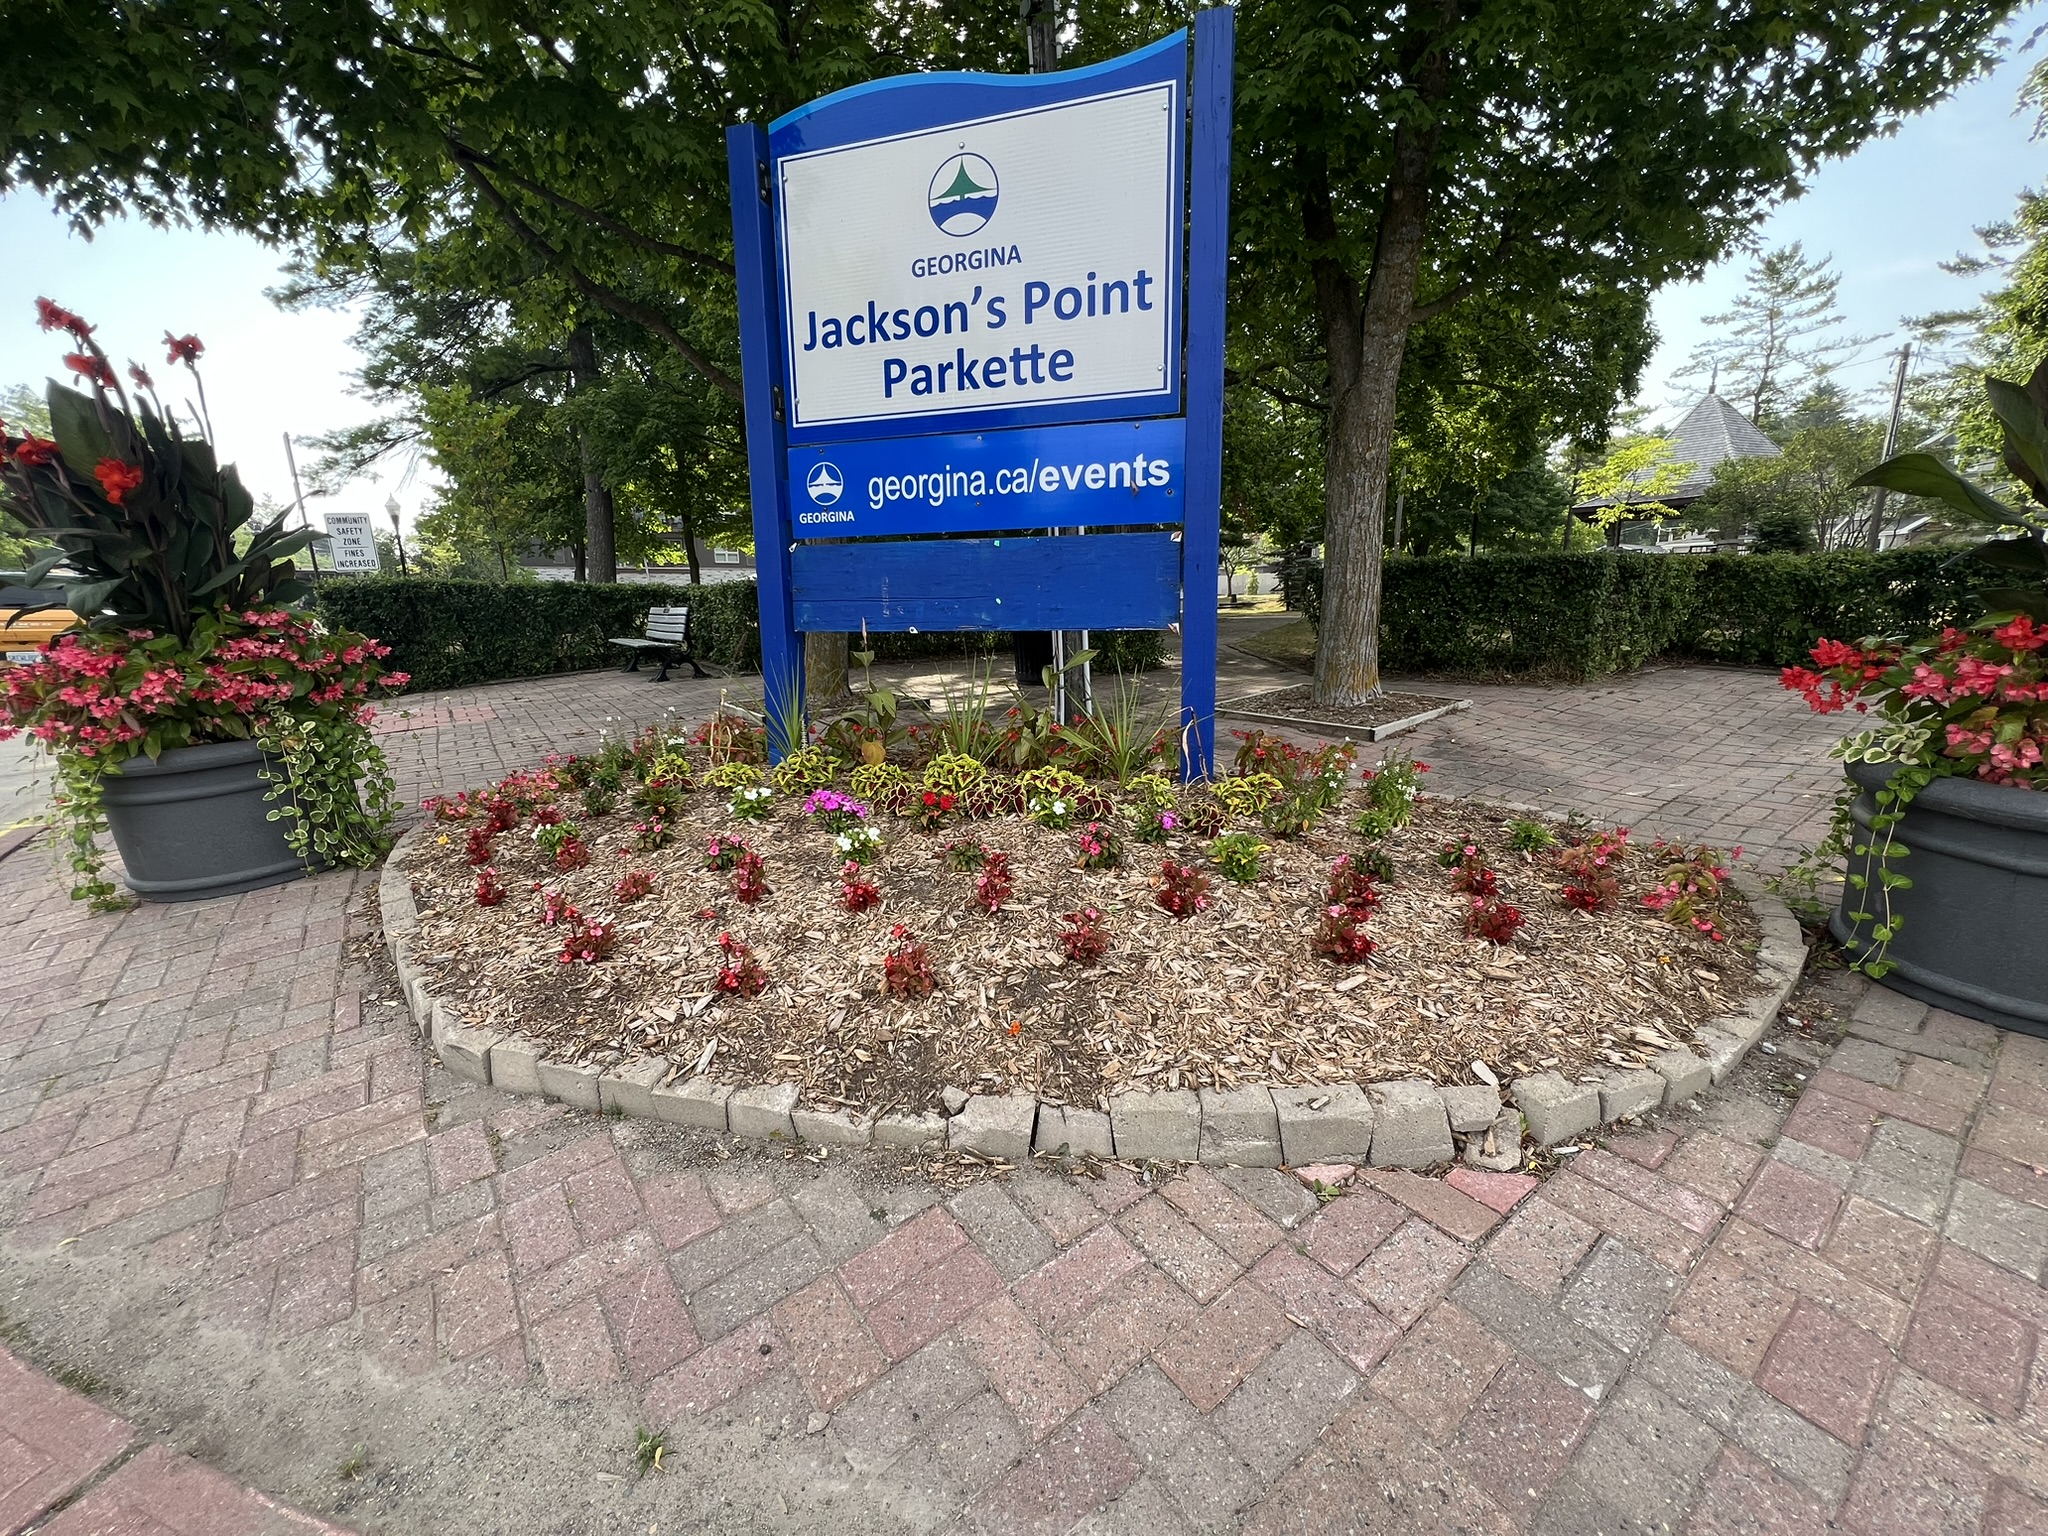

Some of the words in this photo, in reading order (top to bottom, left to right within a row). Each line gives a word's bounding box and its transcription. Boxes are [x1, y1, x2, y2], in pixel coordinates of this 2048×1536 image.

[912, 245, 1022, 277] GEORGINA
[804, 286, 1006, 351] Jackson's
[1024, 270, 1153, 325] Point
[883, 343, 1075, 398] Parkette
[868, 453, 1170, 509] georgina.ca/events
[327, 516, 368, 525] COMMUNITY
[799, 510, 855, 525] GEORGINA
[336, 527, 363, 536] SAFETY
[343, 537, 362, 546] ZONE
[345, 549, 365, 558] FINES
[337, 559, 376, 568] INCREASED
